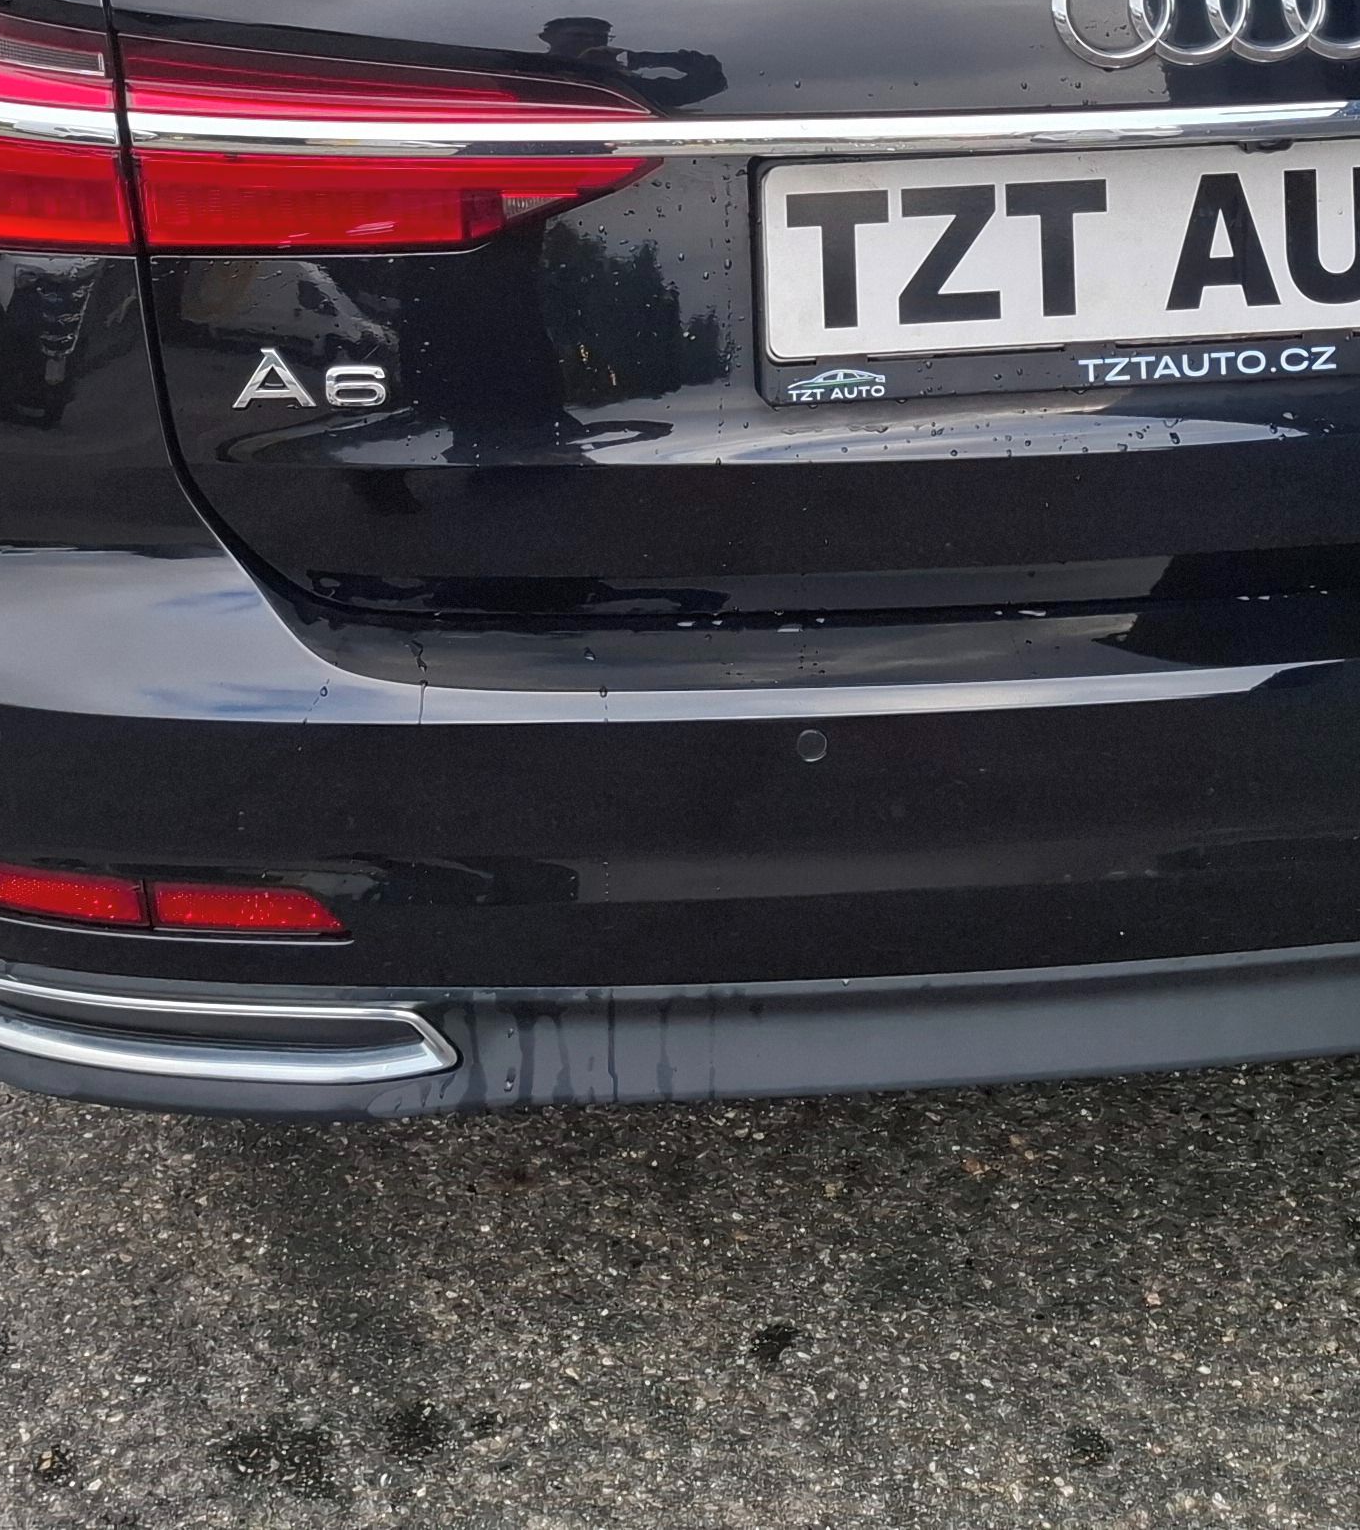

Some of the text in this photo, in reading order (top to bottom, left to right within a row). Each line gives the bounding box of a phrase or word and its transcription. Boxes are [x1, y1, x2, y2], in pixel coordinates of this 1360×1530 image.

[786, 179, 1106, 329] TZT
[232, 348, 387, 409] A6
[1078, 346, 1337, 382] TZTAUTO.CZ
[788, 385, 885, 401] TZT AUTO
